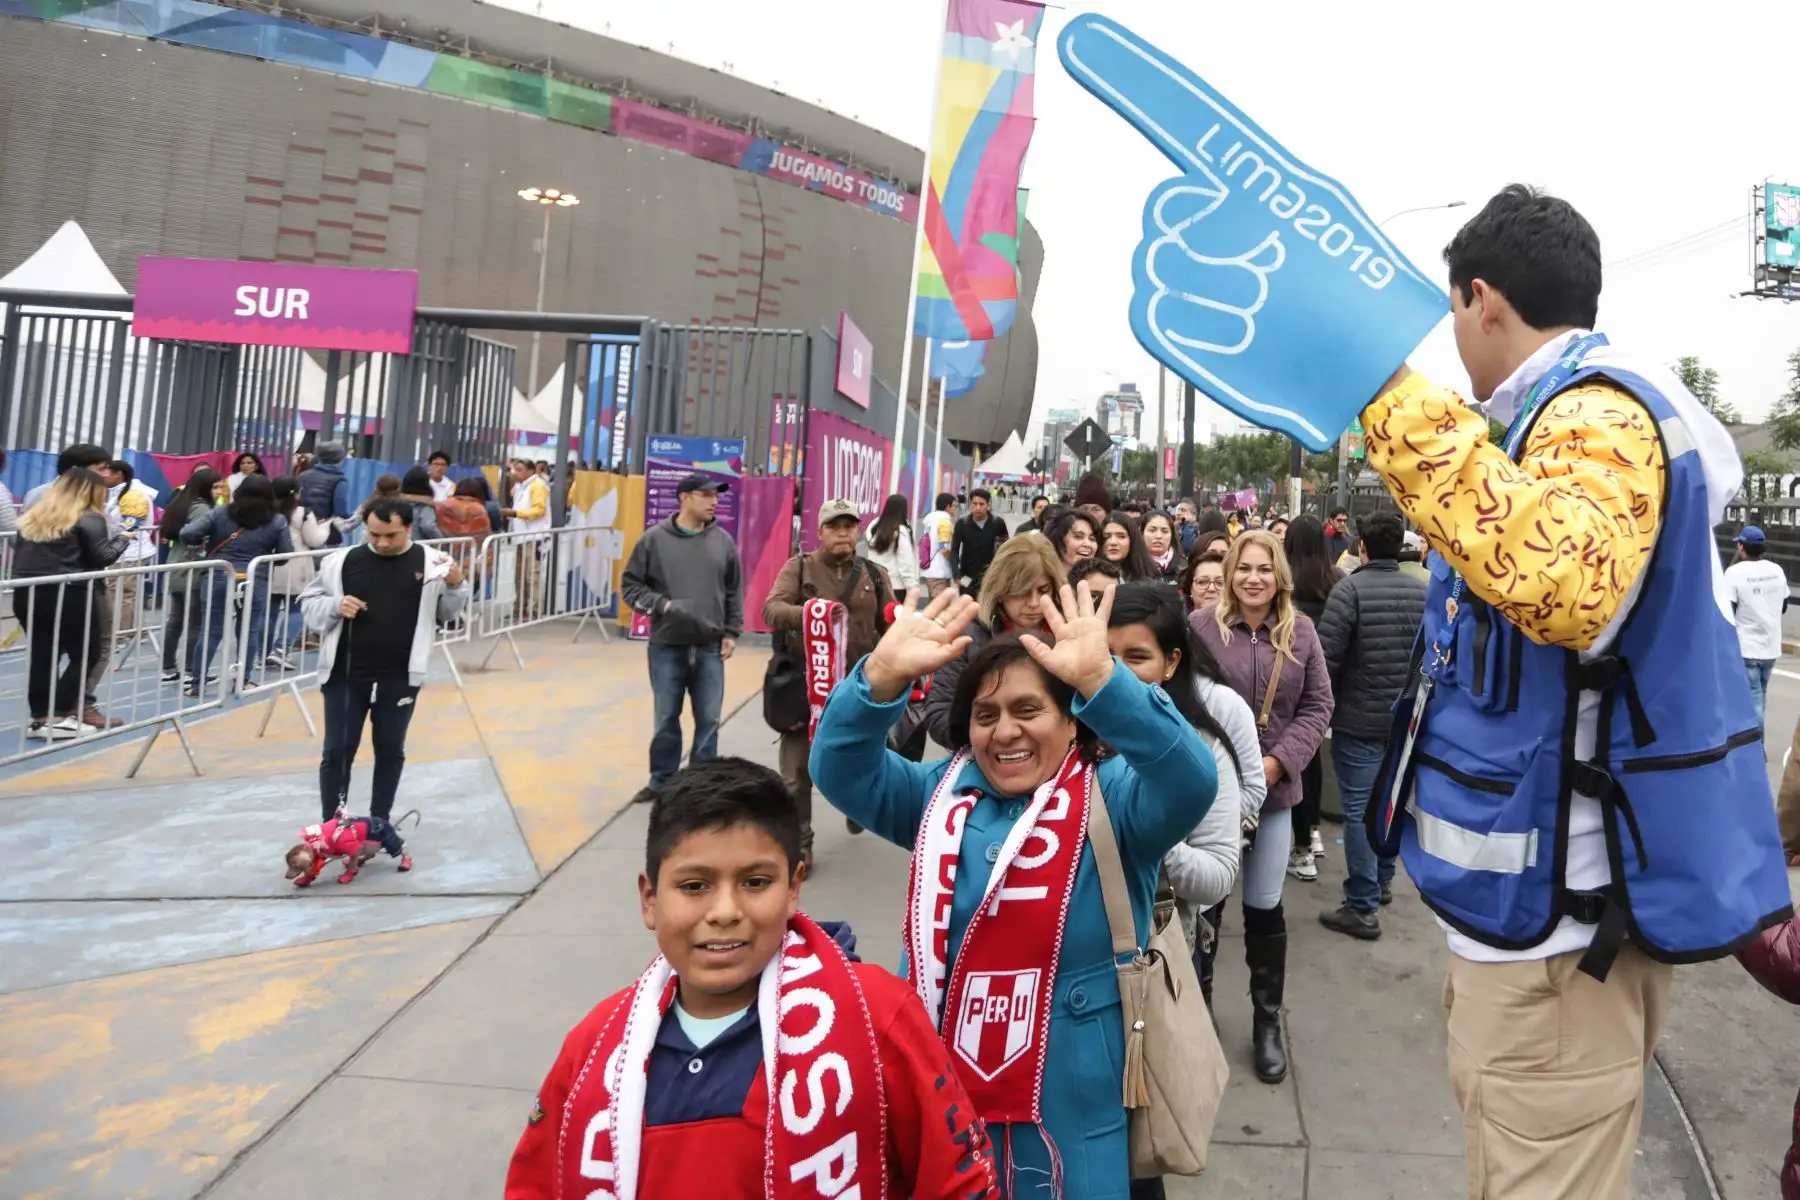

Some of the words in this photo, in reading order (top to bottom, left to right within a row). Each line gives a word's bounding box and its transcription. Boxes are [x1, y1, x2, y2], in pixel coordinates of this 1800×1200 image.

[769, 152, 854, 193] JUGAMOS
[858, 180, 905, 212] TODOS
[234, 285, 310, 319] SUR
[811, 640, 830, 697] PERU
[966, 994, 1029, 1025] PERU
